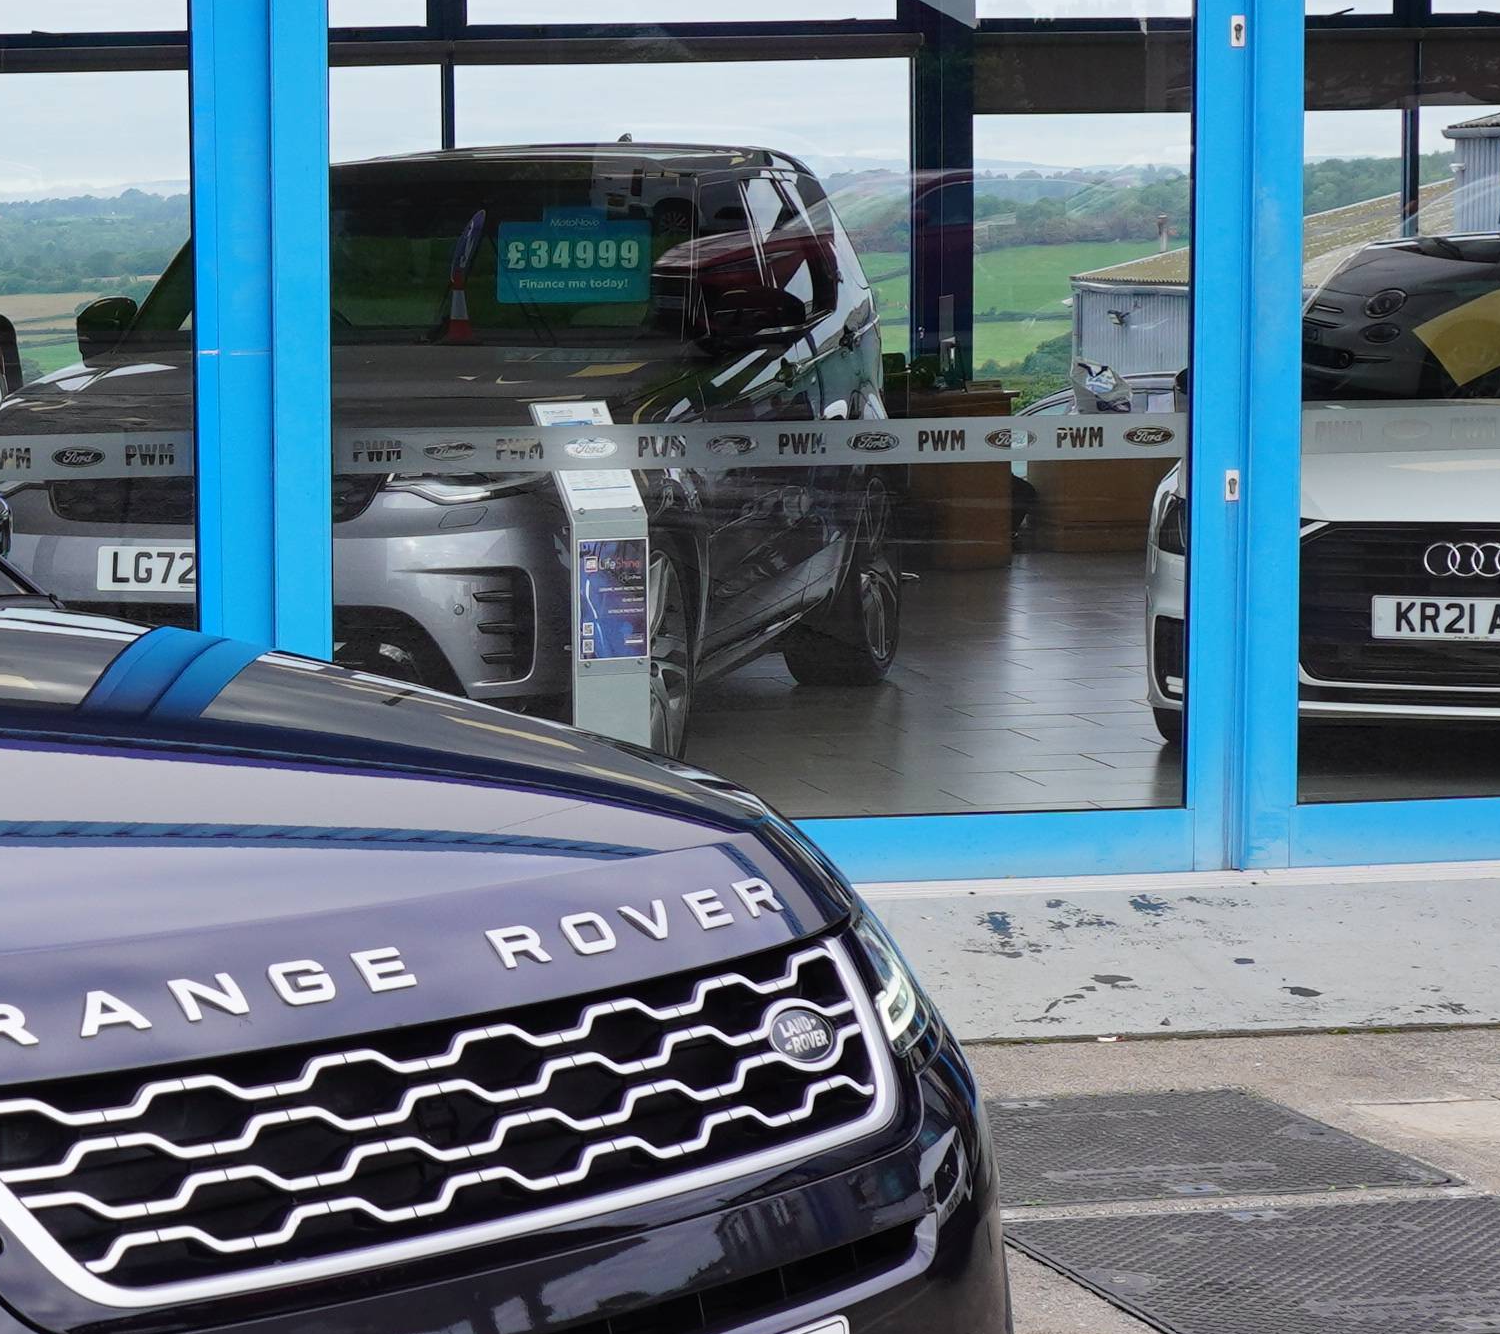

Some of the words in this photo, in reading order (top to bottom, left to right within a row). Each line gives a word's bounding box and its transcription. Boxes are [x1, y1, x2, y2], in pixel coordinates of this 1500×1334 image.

[507, 239, 639, 269] £34999
[519, 279, 565, 289] Finance
[568, 280, 587, 289] me
[590, 278, 629, 292] today!
[56, 448, 100, 466] Ford
[125, 443, 175, 466] PWM
[637, 434, 686, 459] PWM
[917, 428, 966, 453] PWM
[1056, 426, 1105, 450] PWM
[1128, 428, 1172, 445] Ford
[111, 551, 195, 584] LG72
[1395, 601, 1476, 635] KR21
[484, 876, 786, 970] ROVER
[778, 1016, 812, 1038] LAND
[791, 1029, 829, 1053] ROVER
